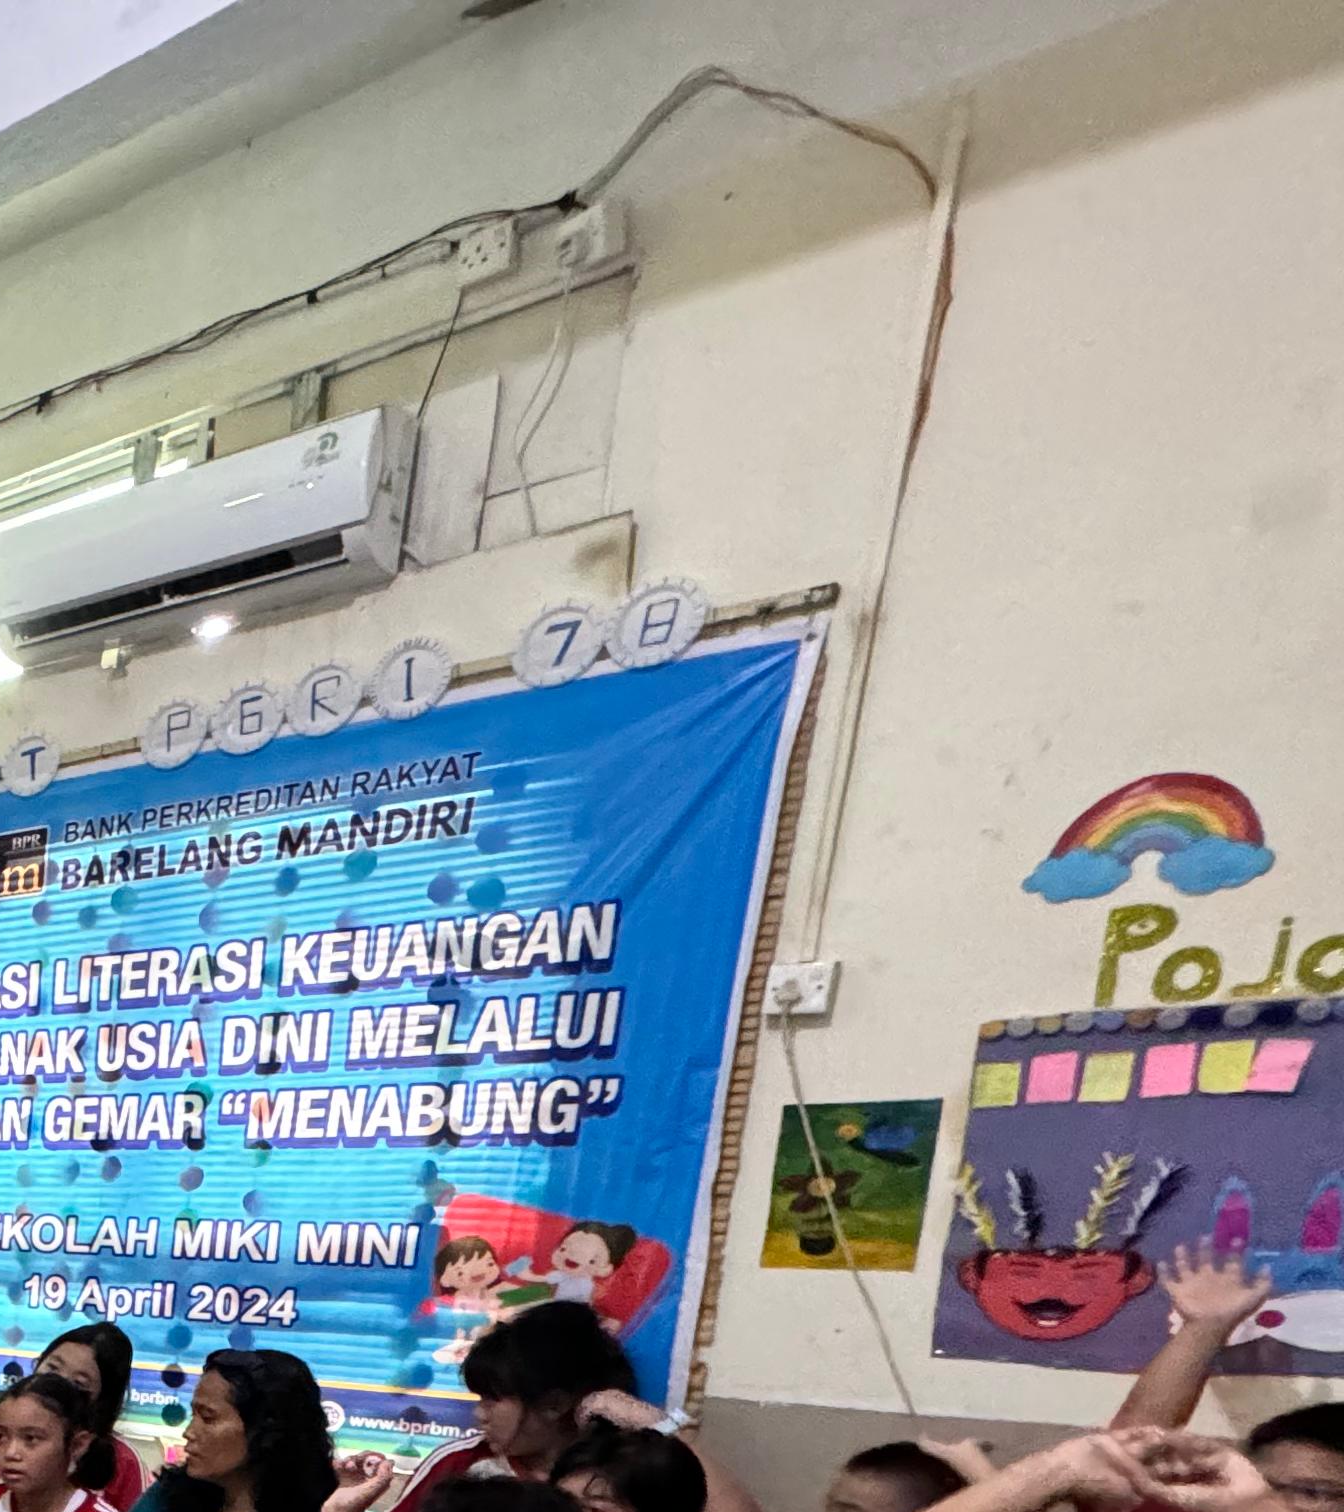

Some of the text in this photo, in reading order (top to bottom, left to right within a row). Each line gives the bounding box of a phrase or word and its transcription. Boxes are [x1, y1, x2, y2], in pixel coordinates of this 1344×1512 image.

[545, 598, 680, 666] 78
[65, 752, 482, 843] BANK PERKREDITAN RAKYAT
[12, 832, 42, 850] BPR
[61, 798, 476, 891] BARELANG MANDIRI
[53, 940, 264, 1010] LITERASI
[282, 906, 620, 988] KEUANGAN
[96, 1020, 207, 1074] USIA
[221, 1008, 333, 1068] DINI
[350, 991, 621, 1061] MELALUI
[45, 1092, 205, 1145] GEMAR
[171, 1218, 279, 1263] MIKI
[297, 1222, 420, 1267] MINI
[24, 1274, 298, 1326] 19 April 2024
[349, 1414, 485, 1438] www.bprbm.c
